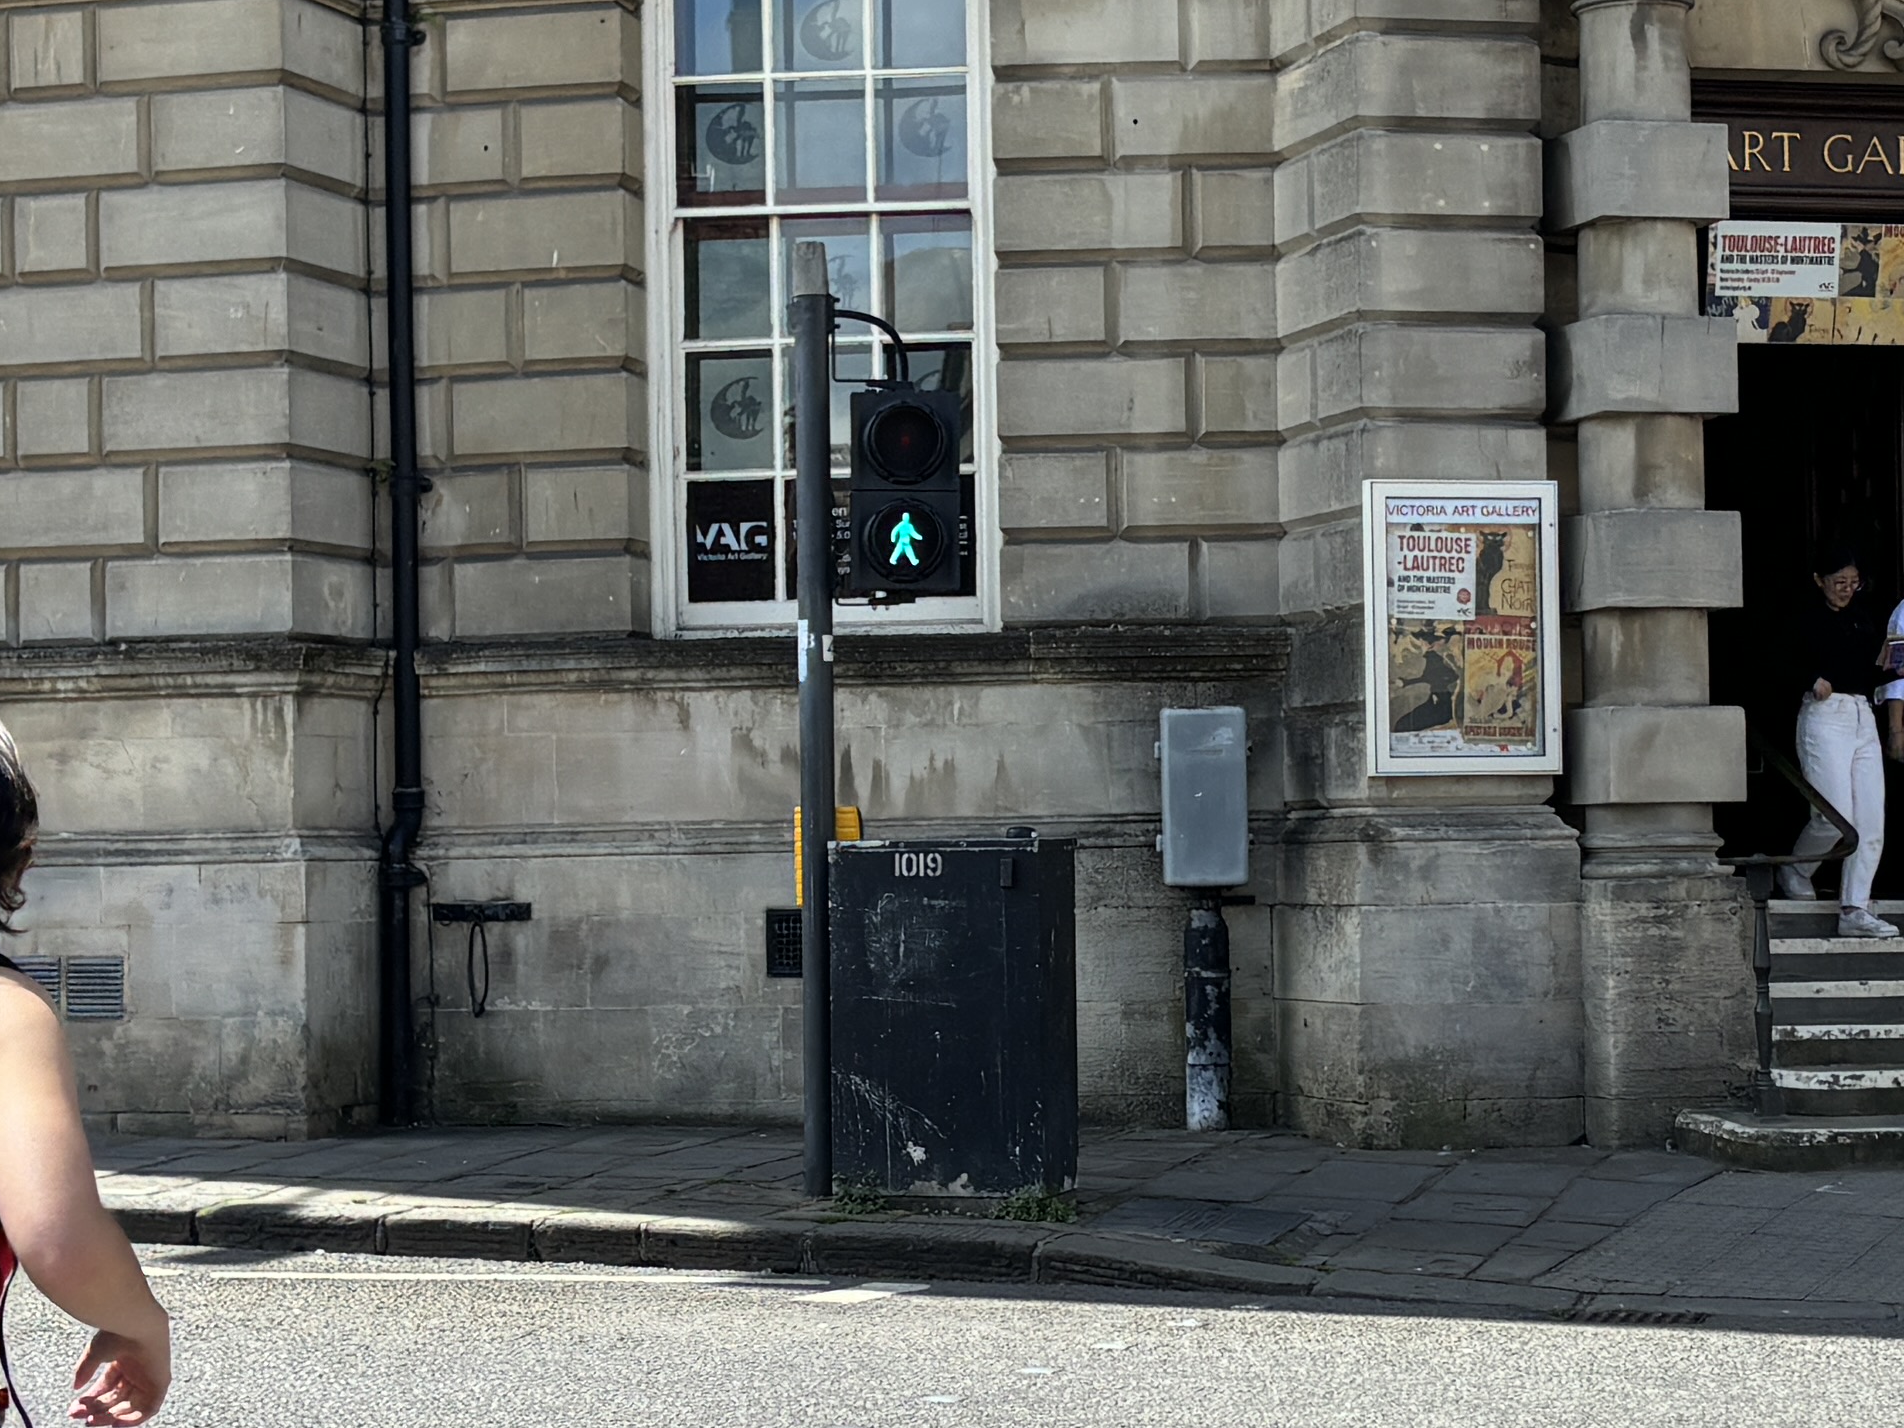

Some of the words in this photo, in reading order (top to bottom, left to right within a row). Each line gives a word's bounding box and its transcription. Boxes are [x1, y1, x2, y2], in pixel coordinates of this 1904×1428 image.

[1721, 234, 1836, 255] TOULOUSE-LAUTREC
[1387, 505, 1448, 517] VICTORIA
[1452, 505, 1478, 517] ART
[1481, 505, 1538, 517] GALLERY
[696, 521, 768, 551] VAG
[1397, 535, 1472, 554] TOULOUSE
[1397, 554, 1466, 573] -LAUTREC
[1466, 637, 1503, 650] MOULIN
[894, 852, 943, 877] 1019
